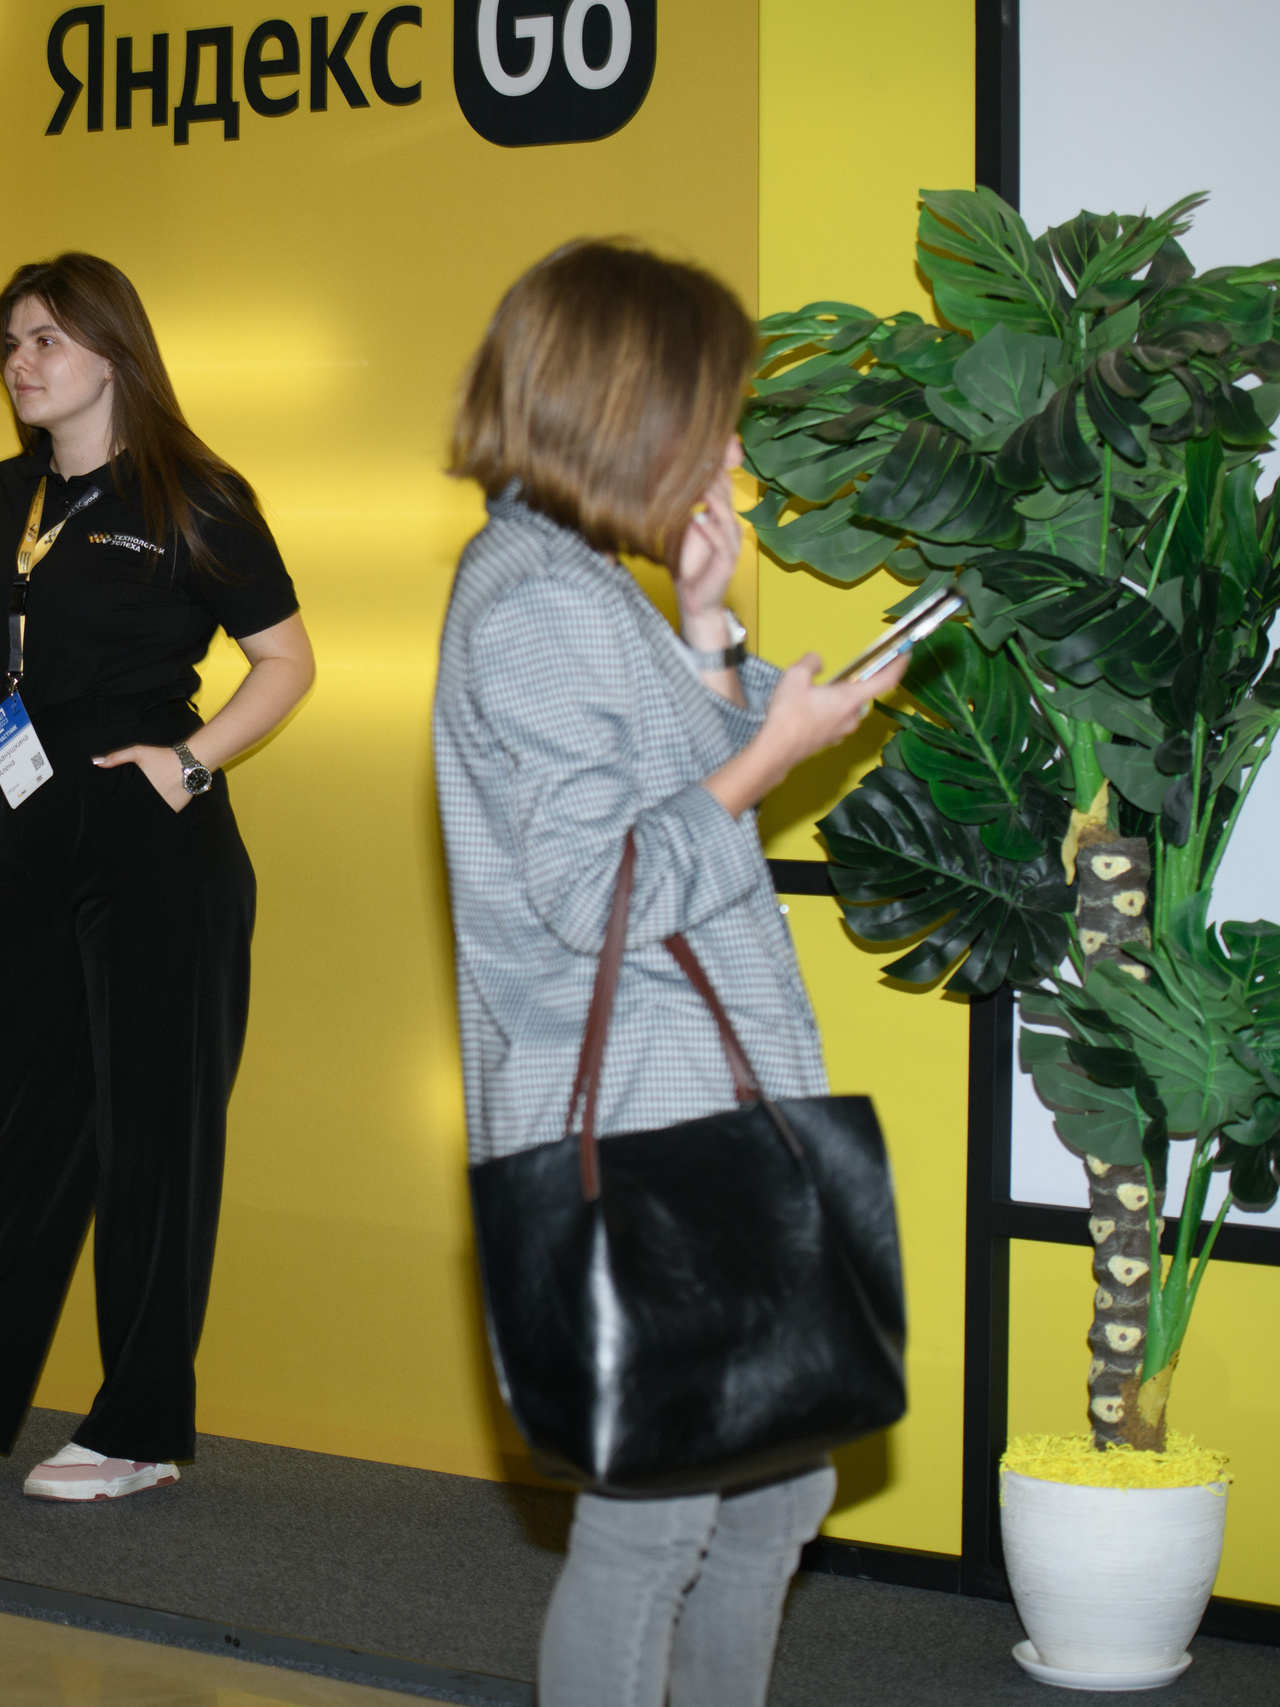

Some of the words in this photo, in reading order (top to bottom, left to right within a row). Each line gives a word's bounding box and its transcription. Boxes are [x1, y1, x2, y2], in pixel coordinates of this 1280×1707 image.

[44, 4, 422, 146] Яндекс
[477, 0, 632, 97] Go
[111, 540, 141, 552] УСПЕХА
